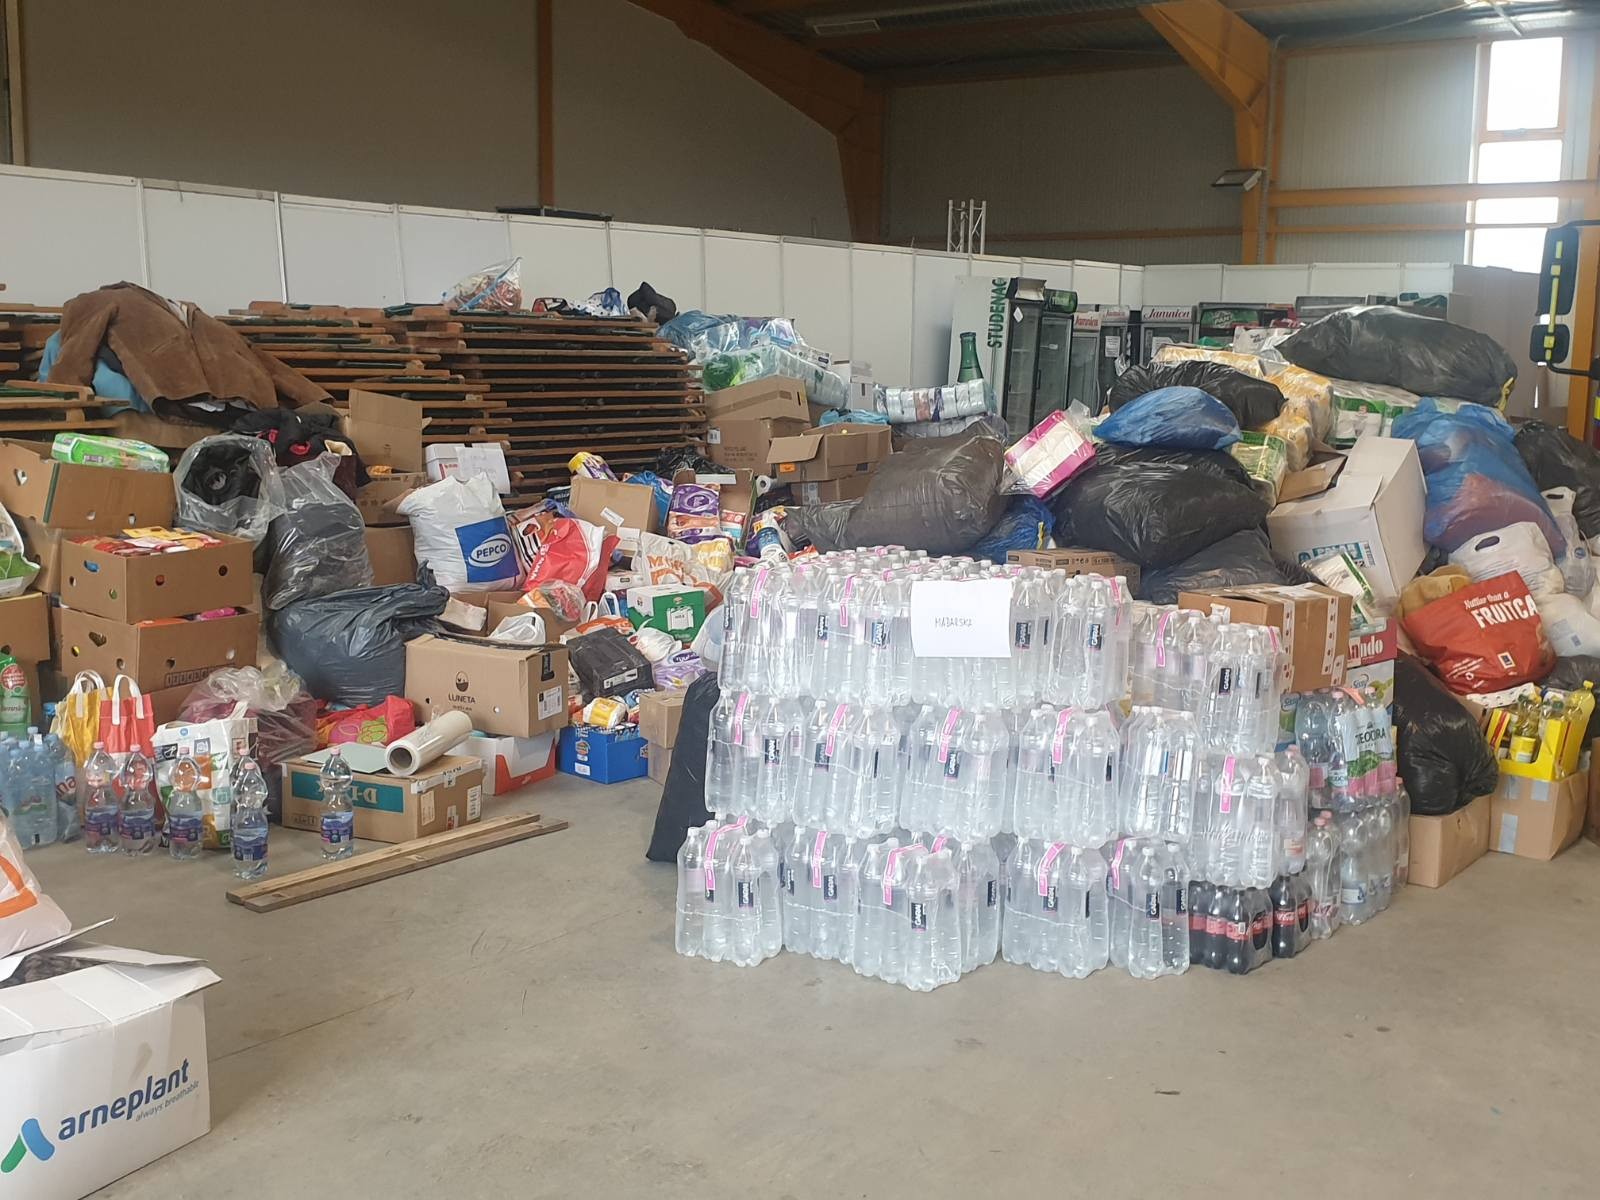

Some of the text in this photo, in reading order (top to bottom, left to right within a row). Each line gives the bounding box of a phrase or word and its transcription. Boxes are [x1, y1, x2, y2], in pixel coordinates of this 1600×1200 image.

[986, 277, 1008, 349] STUDENAC
[1143, 307, 1191, 319] Jamnica
[475, 543, 508, 559] PEPCO
[447, 693, 476, 704] LUNETA
[58, 1058, 189, 1141] arneplant
[135, 1080, 200, 1122] always breathable
